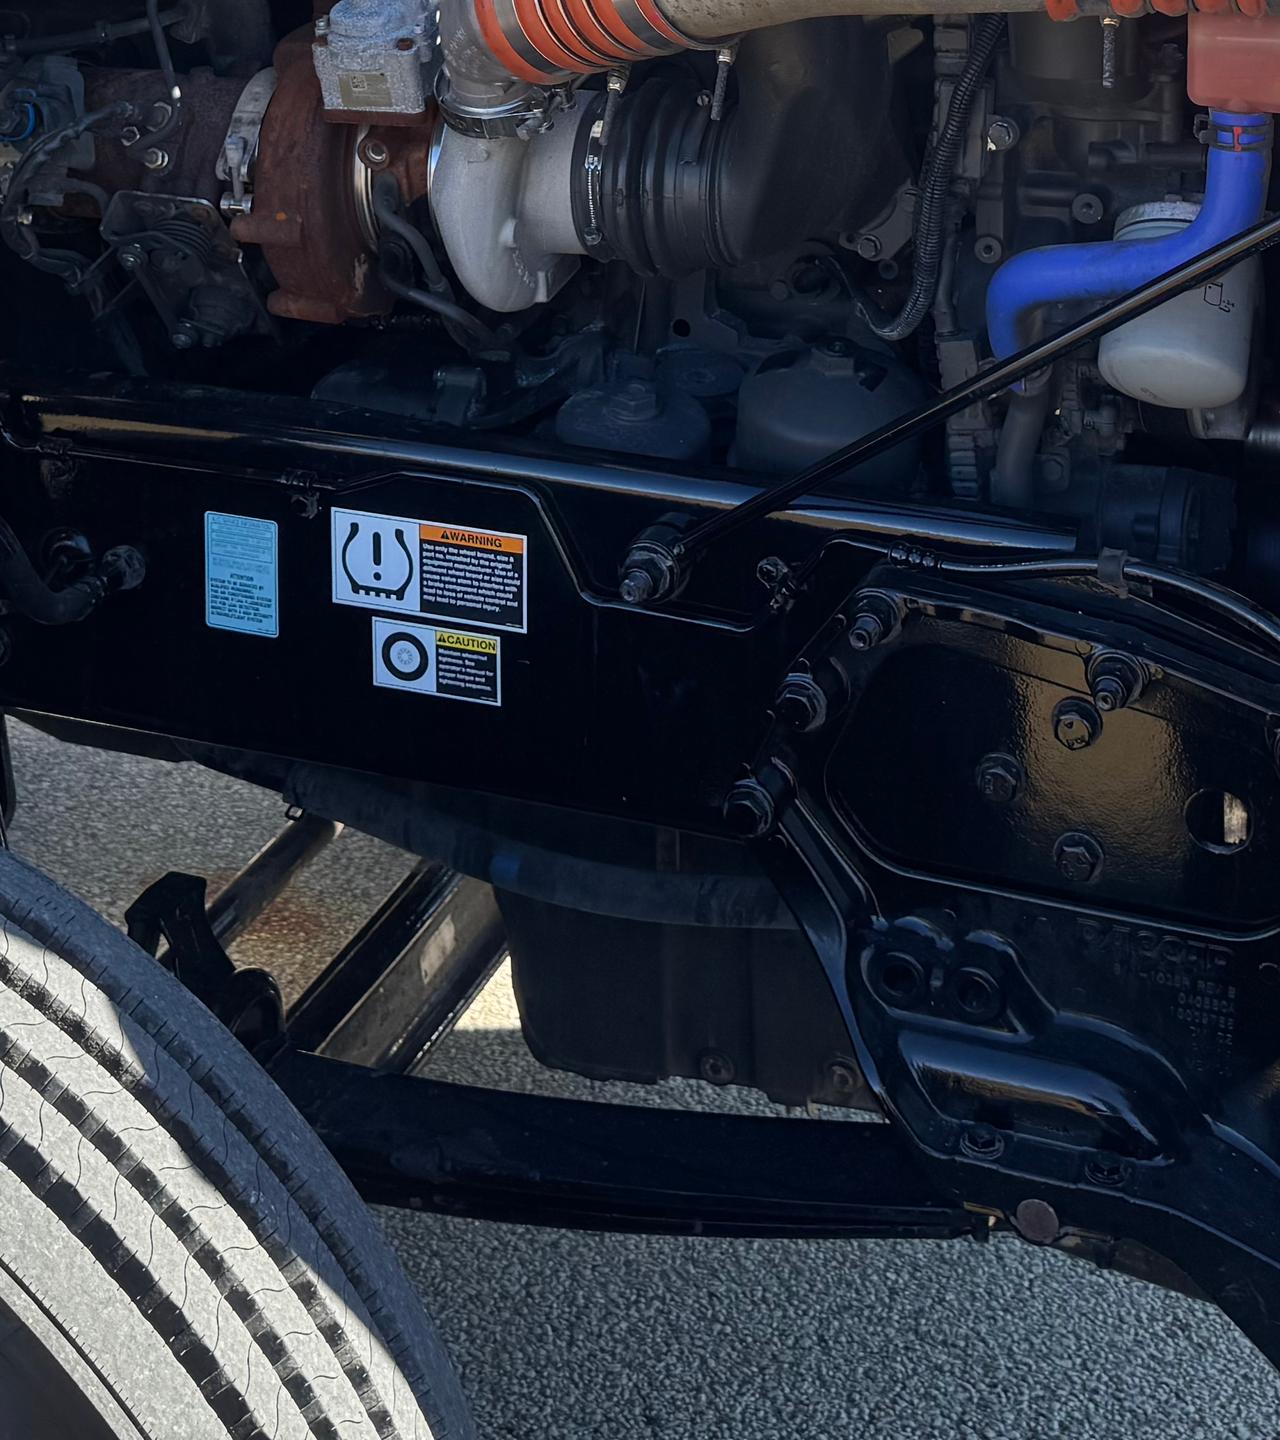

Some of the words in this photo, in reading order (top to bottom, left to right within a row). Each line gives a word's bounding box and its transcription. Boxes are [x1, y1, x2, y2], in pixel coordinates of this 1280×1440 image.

[423, 543, 434, 551] Use
[435, 545, 447, 553] only
[450, 531, 502, 549] WARNING
[447, 635, 496, 652] CAUTION
